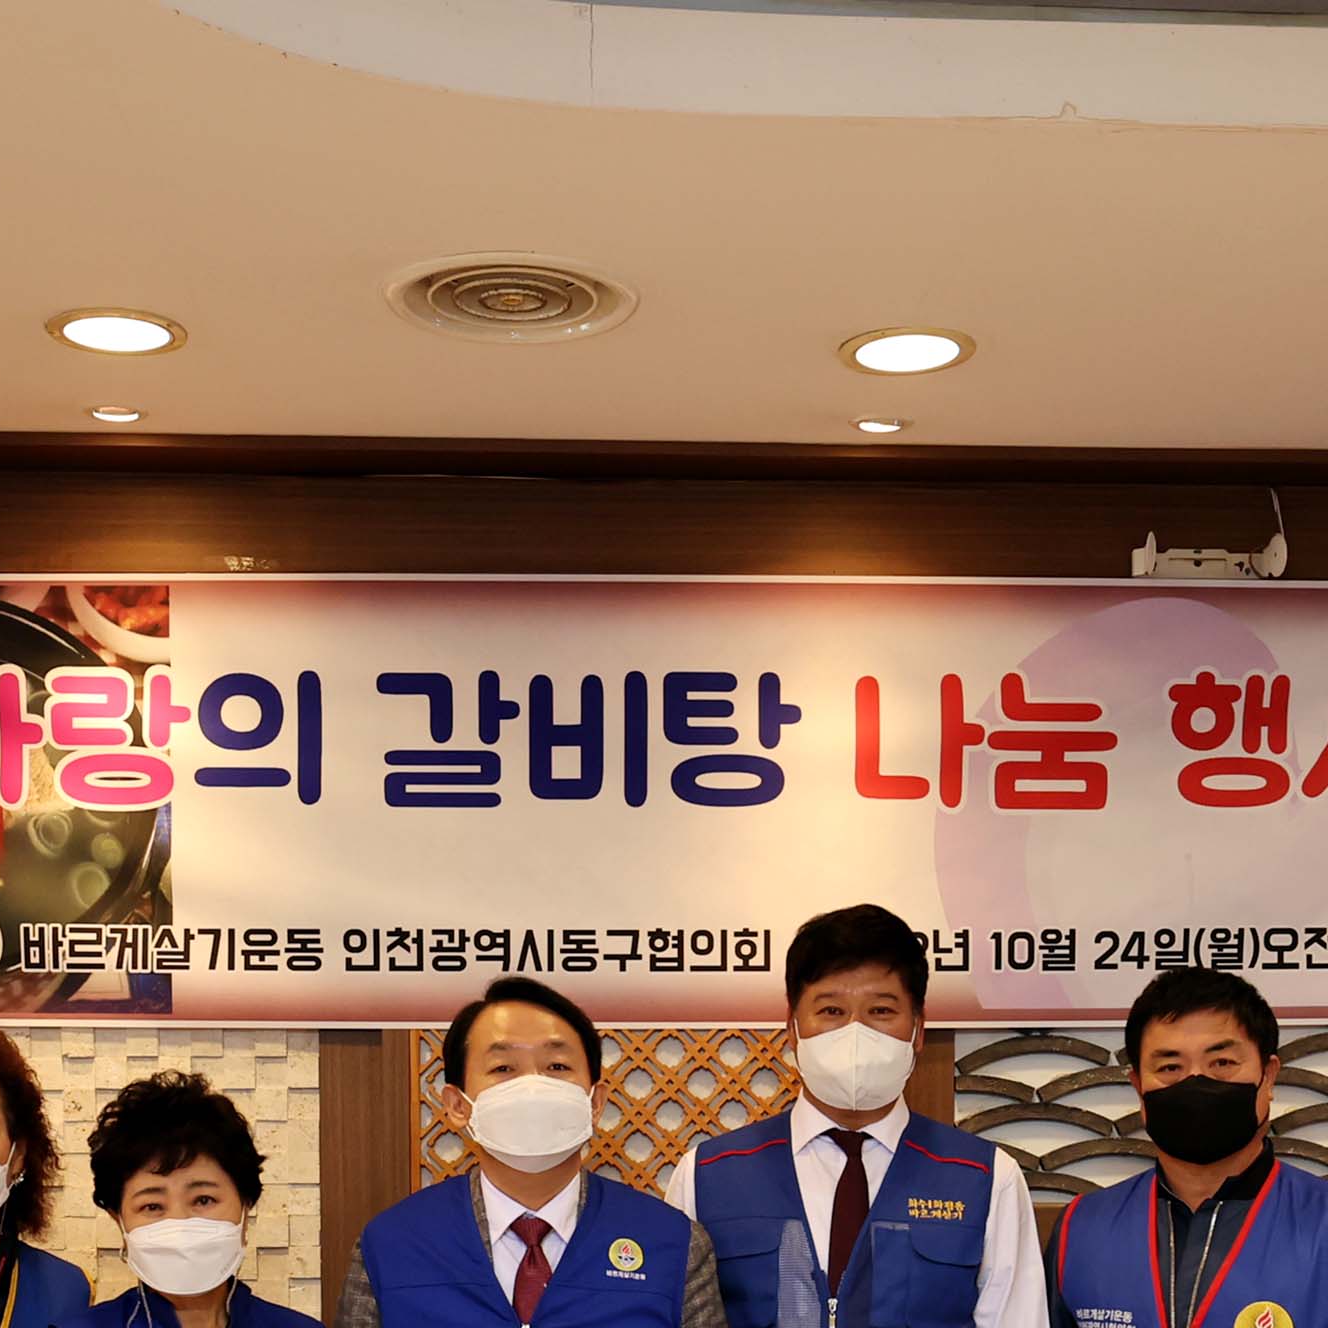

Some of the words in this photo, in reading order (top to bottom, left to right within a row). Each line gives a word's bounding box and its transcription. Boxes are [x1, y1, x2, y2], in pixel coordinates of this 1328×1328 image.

[377, 669, 802, 809] 갈비탕
[855, 671, 1118, 811] 나눔
[21, 927, 324, 973] 바르게살기운동
[343, 927, 771, 973] 인천광역시동구협의회
[989, 928, 1076, 972] 10월
